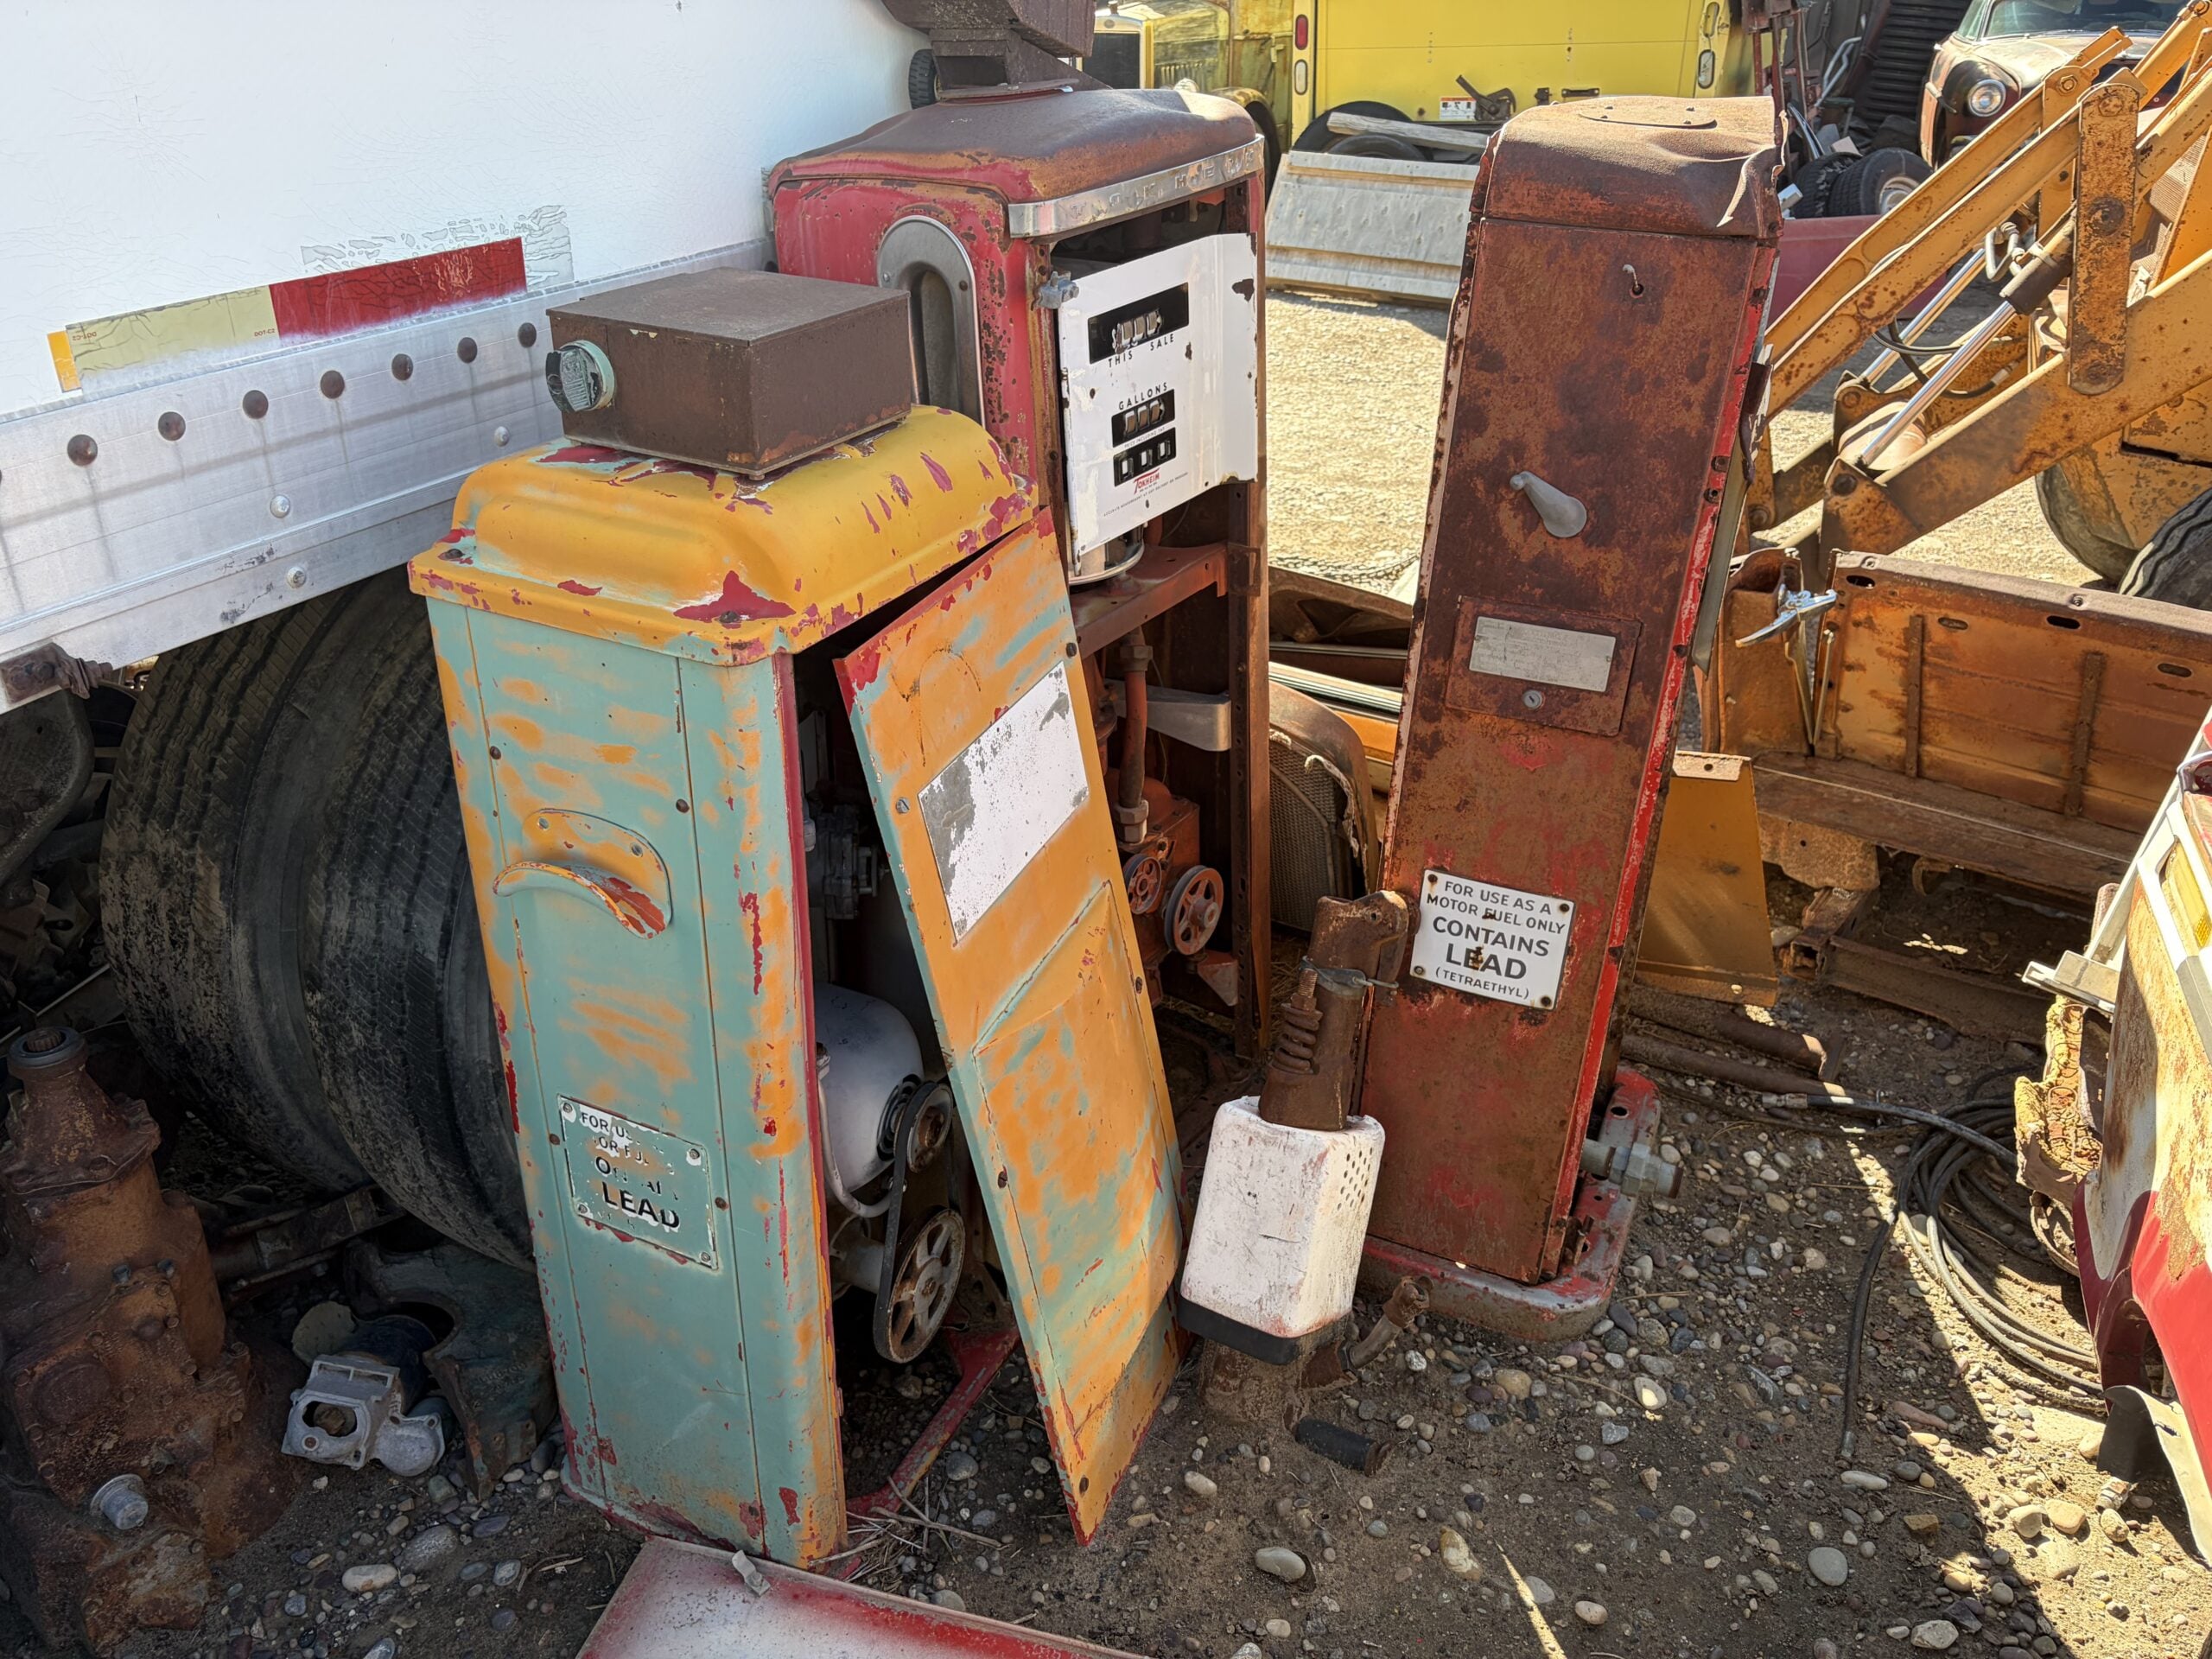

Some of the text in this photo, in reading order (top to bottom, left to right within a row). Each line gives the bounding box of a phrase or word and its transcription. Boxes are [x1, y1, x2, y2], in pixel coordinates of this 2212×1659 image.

[254, 328, 276, 337] DOT-C2
[1109, 334, 1174, 368] THIS SALE
[1118, 382, 1167, 410] GALLONS
[1133, 467, 1160, 495] TOKHEIM
[1426, 893, 1566, 935] MOTOR FUEL ONLY
[1444, 880, 1552, 915] FOR USE AS A
[1433, 916, 1550, 957] CONTAINS
[1445, 943, 1527, 980] LEAD
[582, 1112, 609, 1132] FOR
[601, 1180, 680, 1229] LEAD
